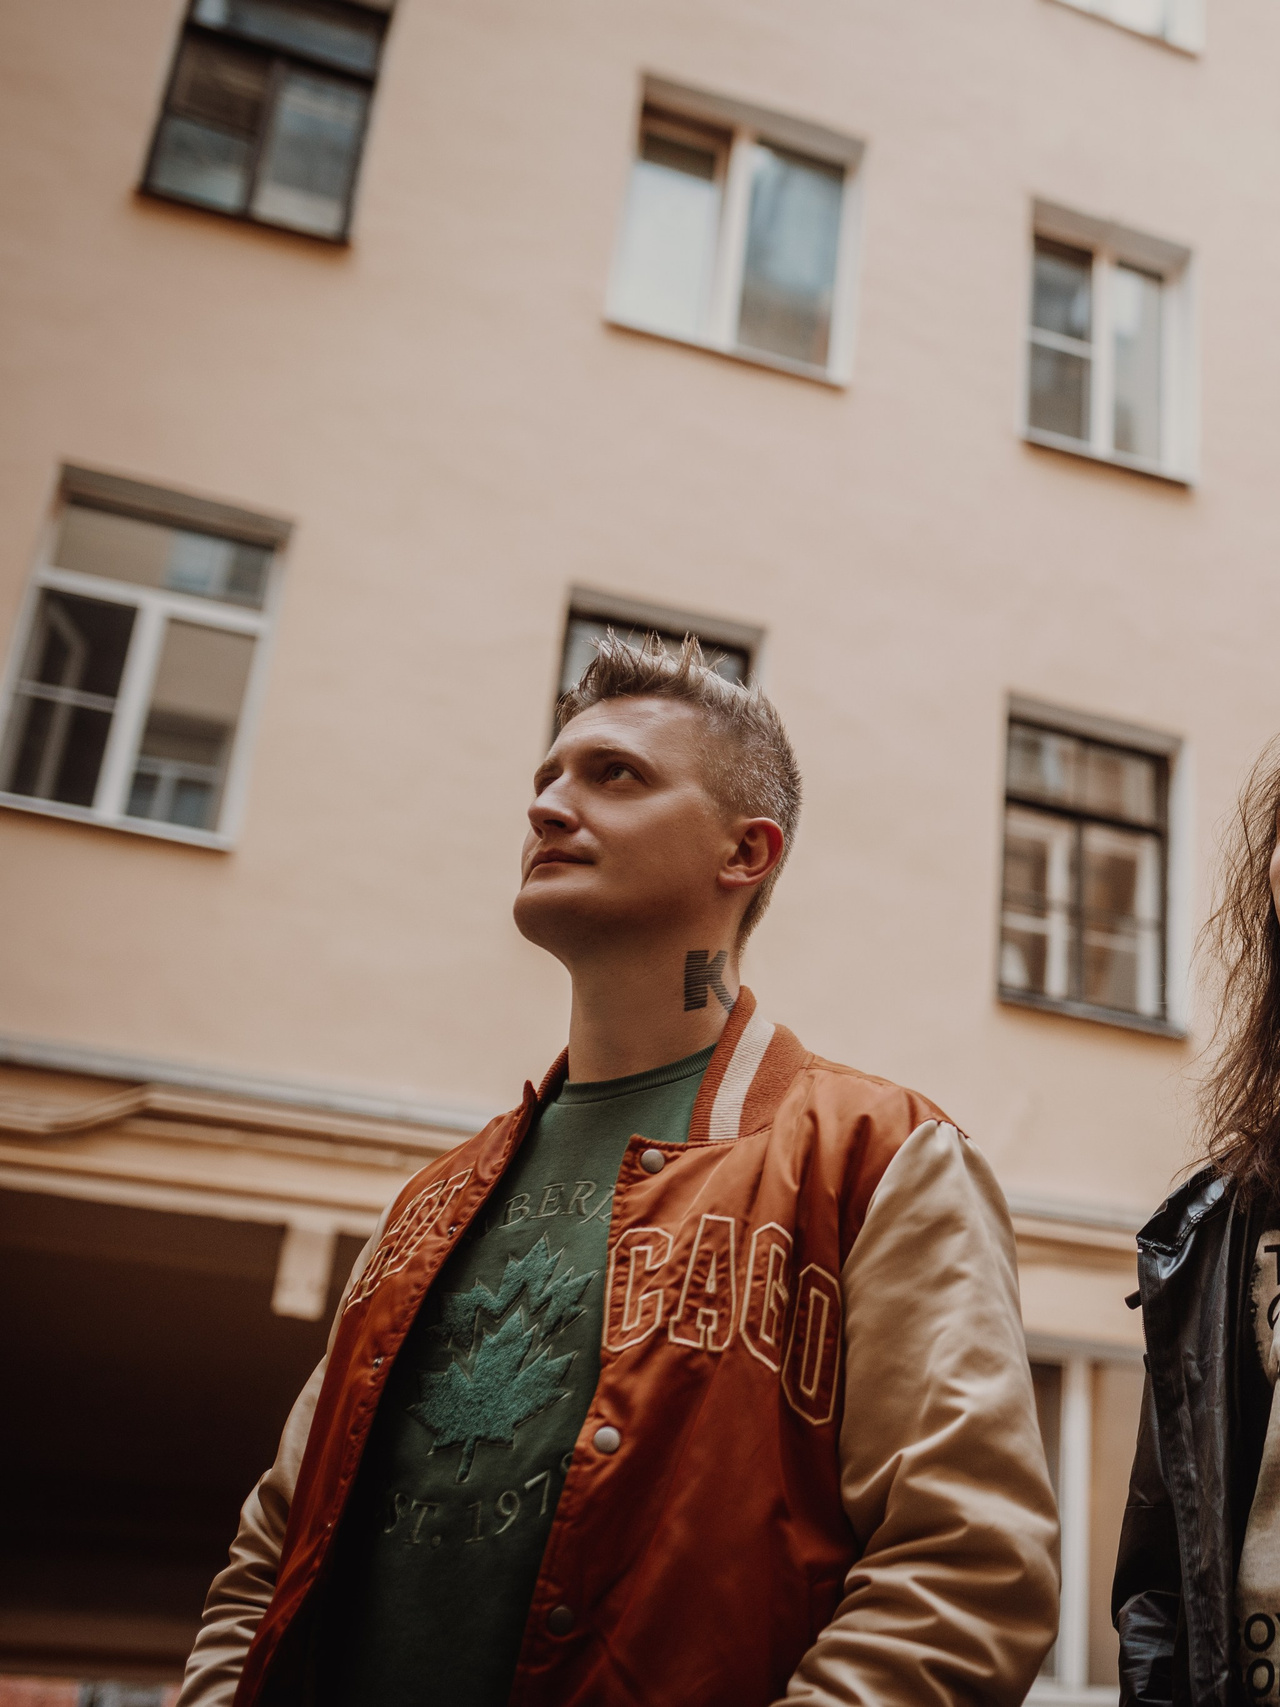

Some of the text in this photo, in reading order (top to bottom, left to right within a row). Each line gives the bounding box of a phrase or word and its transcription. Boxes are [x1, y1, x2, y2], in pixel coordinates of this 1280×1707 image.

[684, 950, 736, 1013] K
[602, 1213, 842, 1426] CAGO
[383, 1492, 442, 1548] ST.
